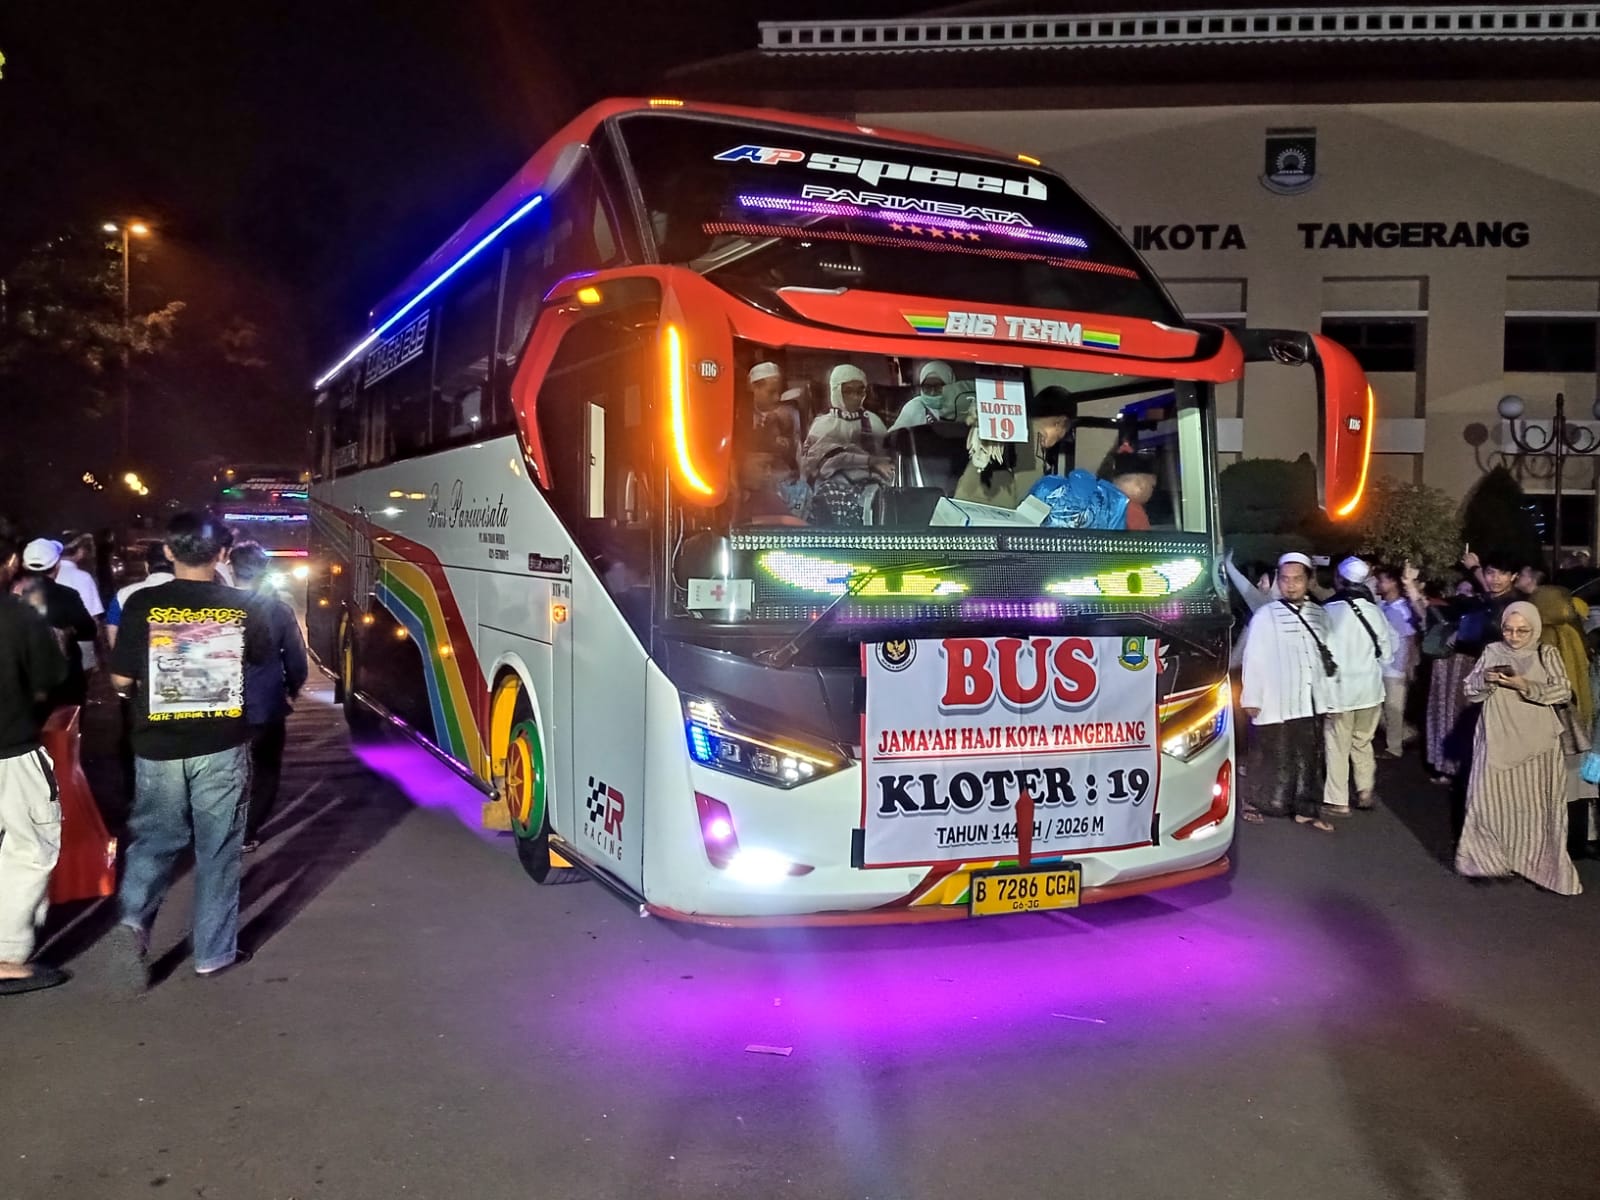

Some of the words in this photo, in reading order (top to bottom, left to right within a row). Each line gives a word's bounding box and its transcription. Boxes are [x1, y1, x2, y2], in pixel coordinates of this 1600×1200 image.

[806, 152, 1047, 201] speed
[801, 184, 1033, 227] PARIWISATA
[1298, 222, 1530, 248] TANGERANG
[1004, 315, 1083, 346] TEAM
[980, 402, 1022, 416] KLOTER
[989, 417, 1015, 439] 19
[449, 479, 509, 528] Pariwisata
[939, 637, 1098, 709] BUS
[878, 728, 957, 753] JAMA'AH
[960, 726, 1001, 750] HAJI
[1005, 725, 1049, 748] KOTA
[1052, 721, 1146, 746] TANGERANG
[878, 767, 1077, 814] KLOTER
[1109, 768, 1150, 802] 19
[936, 825, 989, 845] TAHUN
[993, 822, 1018, 840] 144
[1056, 817, 1089, 835] 2026
[1092, 815, 1104, 833] M
[976, 881, 986, 903] B
[997, 876, 1038, 900] 7286
[1045, 874, 1076, 897] CGA
